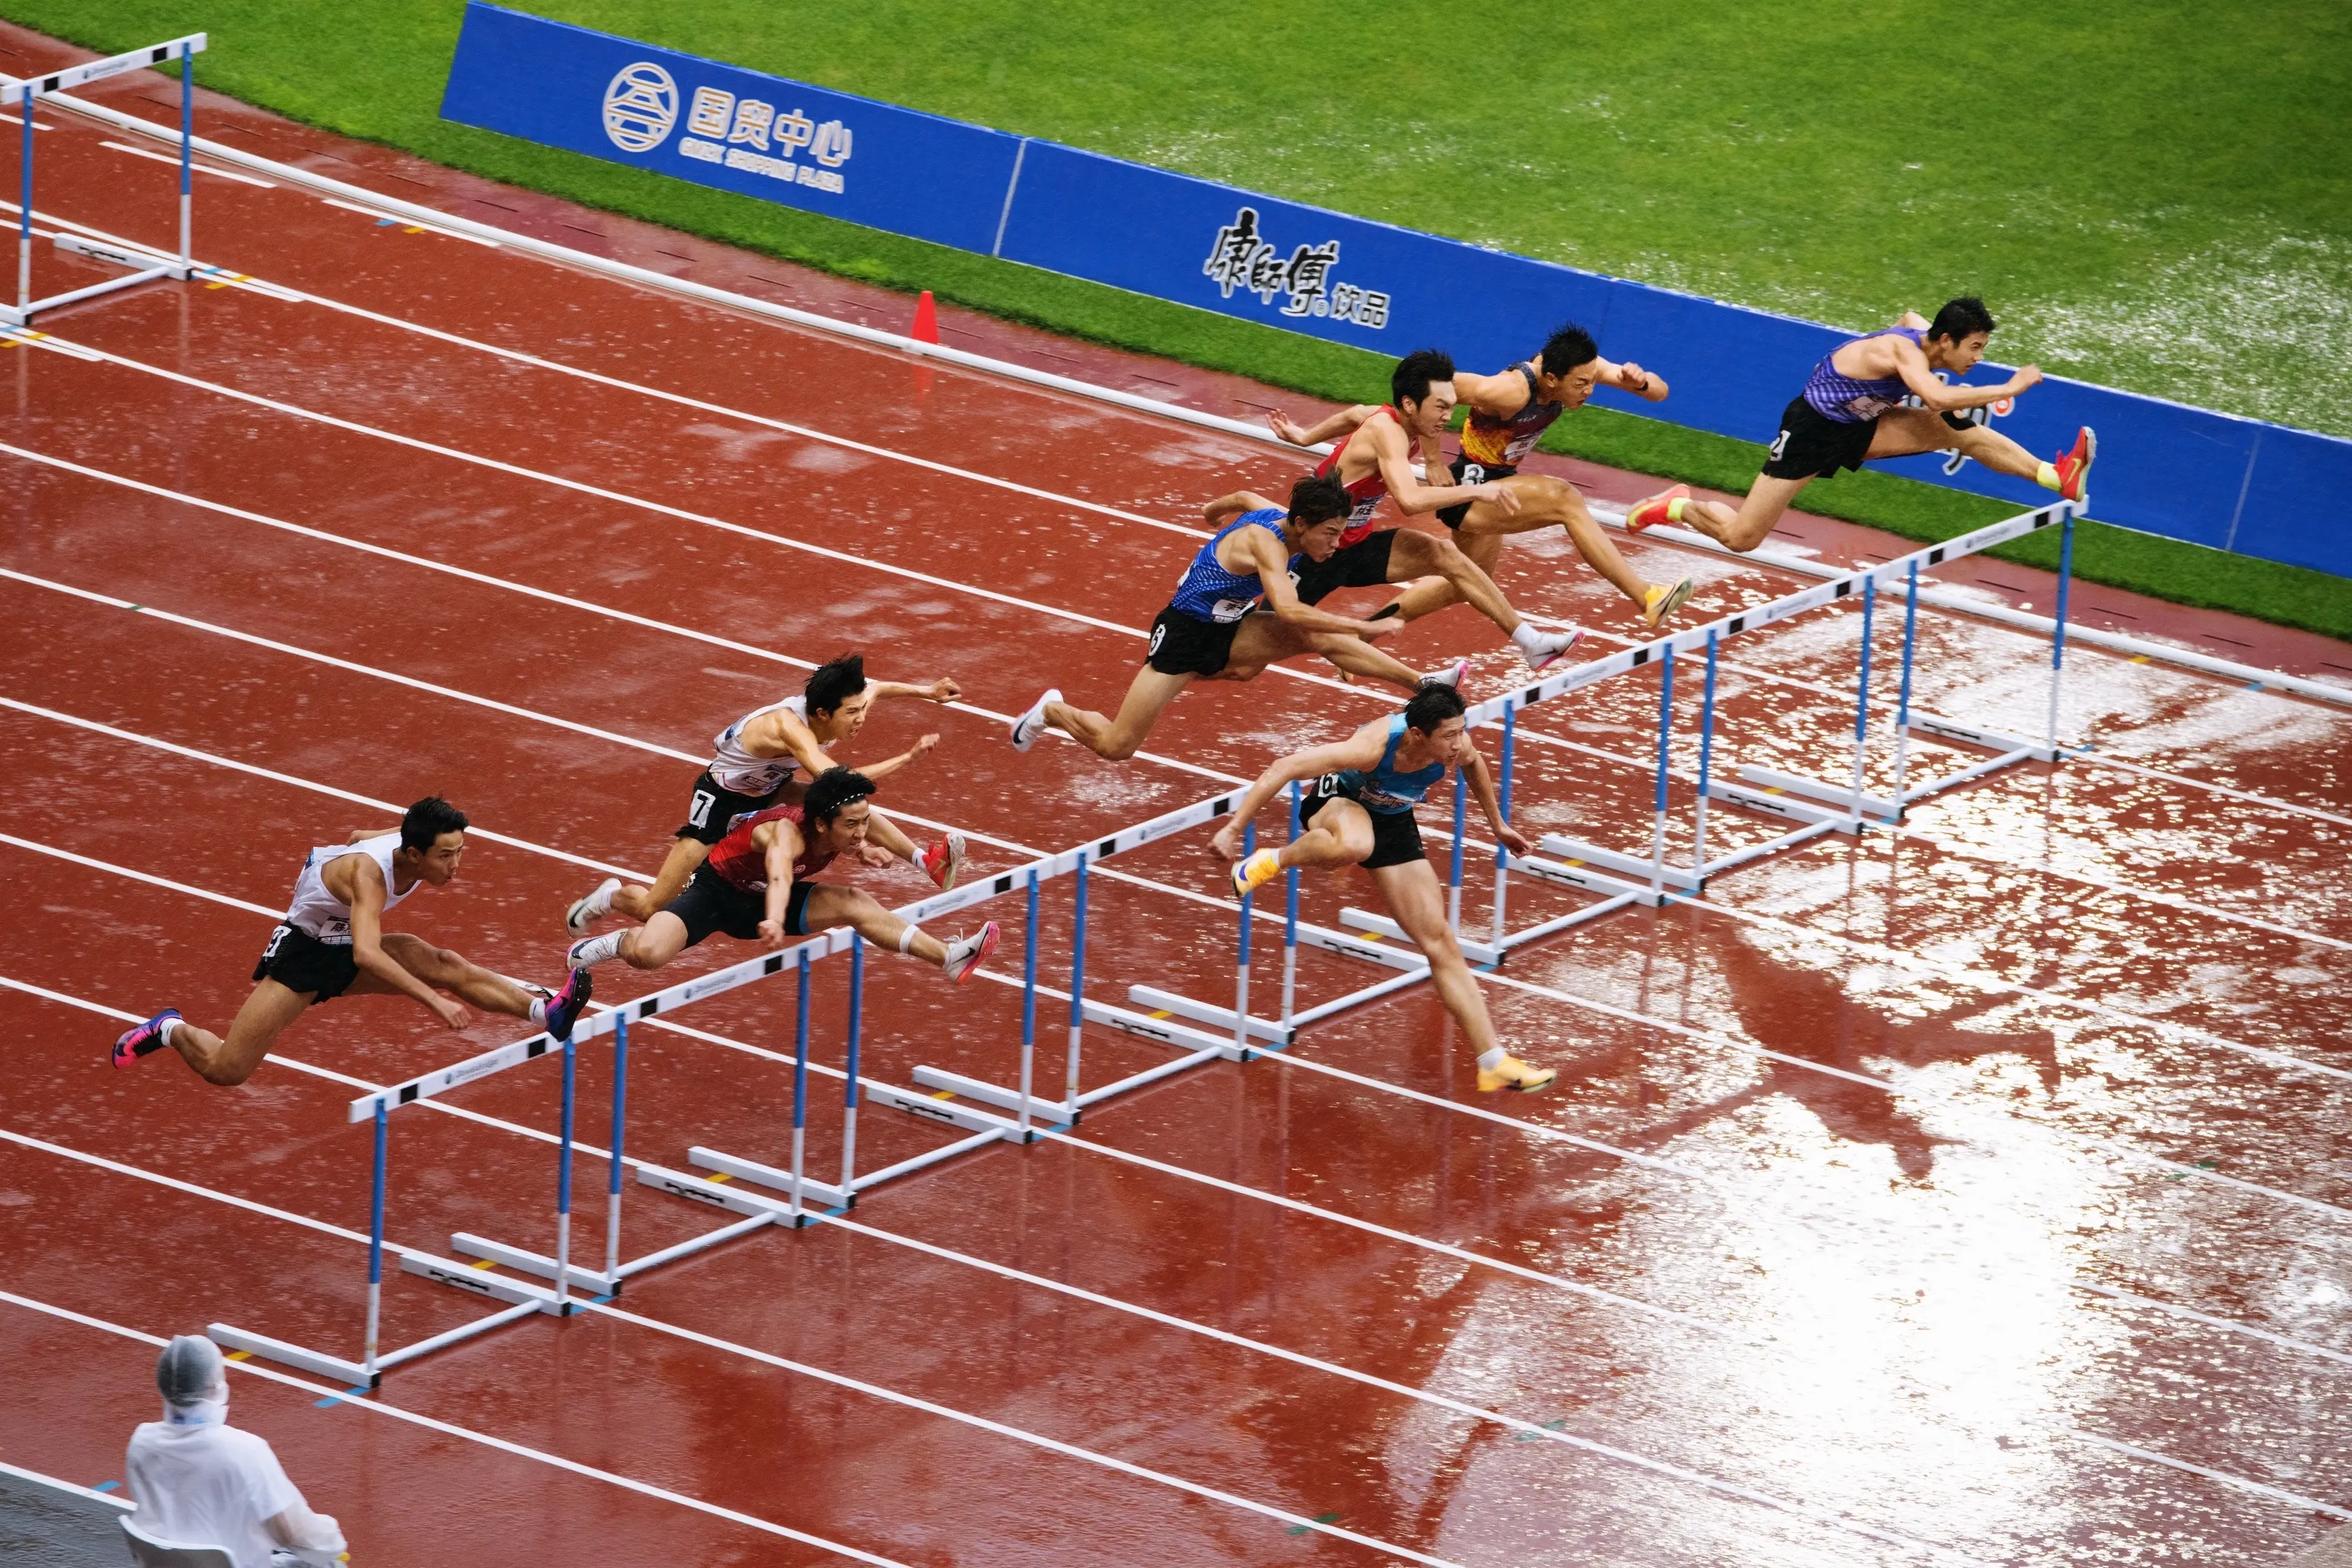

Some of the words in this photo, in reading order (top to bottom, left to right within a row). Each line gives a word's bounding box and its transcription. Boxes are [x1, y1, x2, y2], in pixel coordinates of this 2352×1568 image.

[687, 86, 852, 167] 国贸中心
[724, 148, 797, 181] SHOPPING
[796, 166, 844, 194] PLAZA
[692, 793, 709, 821] 7
